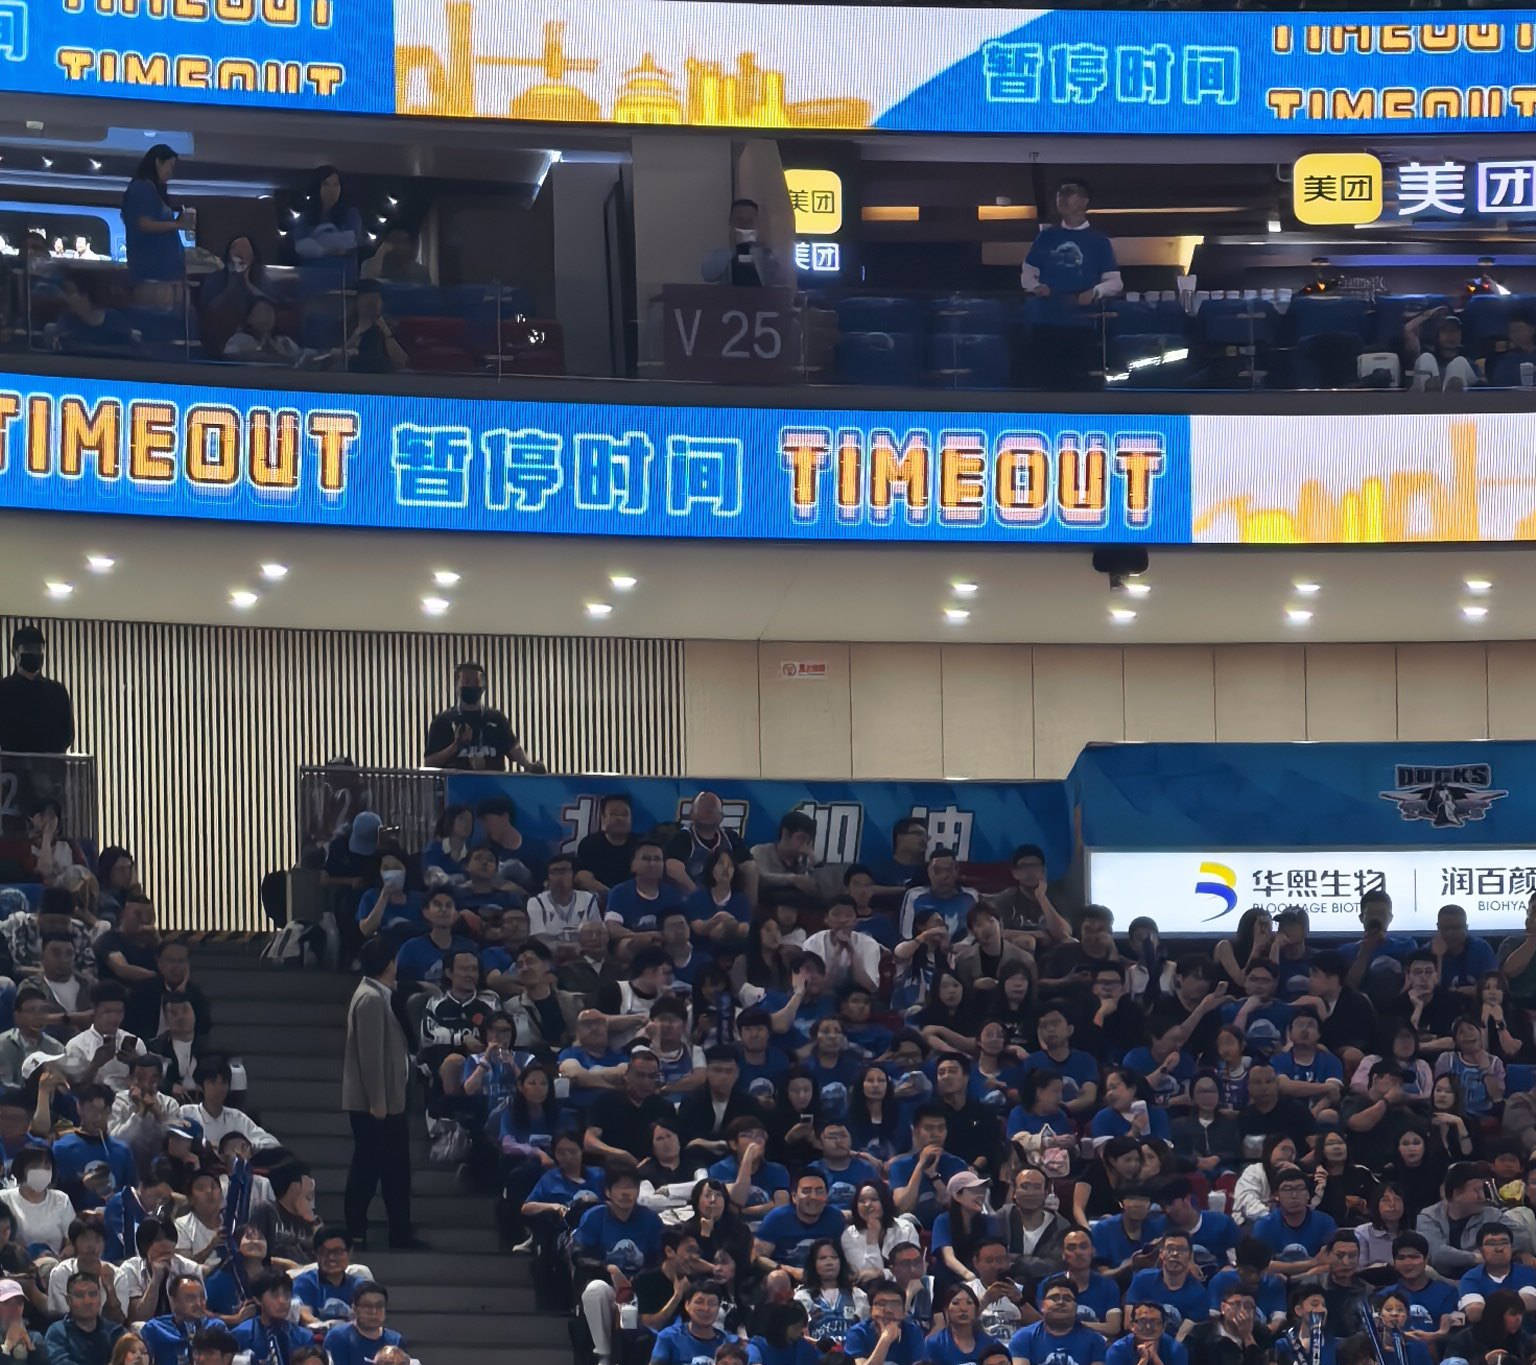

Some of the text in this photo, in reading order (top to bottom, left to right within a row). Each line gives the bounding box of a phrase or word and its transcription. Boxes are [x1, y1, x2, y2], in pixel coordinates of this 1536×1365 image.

[982, 41, 1241, 105] 暂停时间
[1303, 174, 1373, 203] 美团
[674, 309, 782, 359] V 25
[393, 422, 743, 518] 暂停时间
[780, 427, 1166, 528] TIMEOUT
[1252, 869, 1386, 897] 华熙生物
